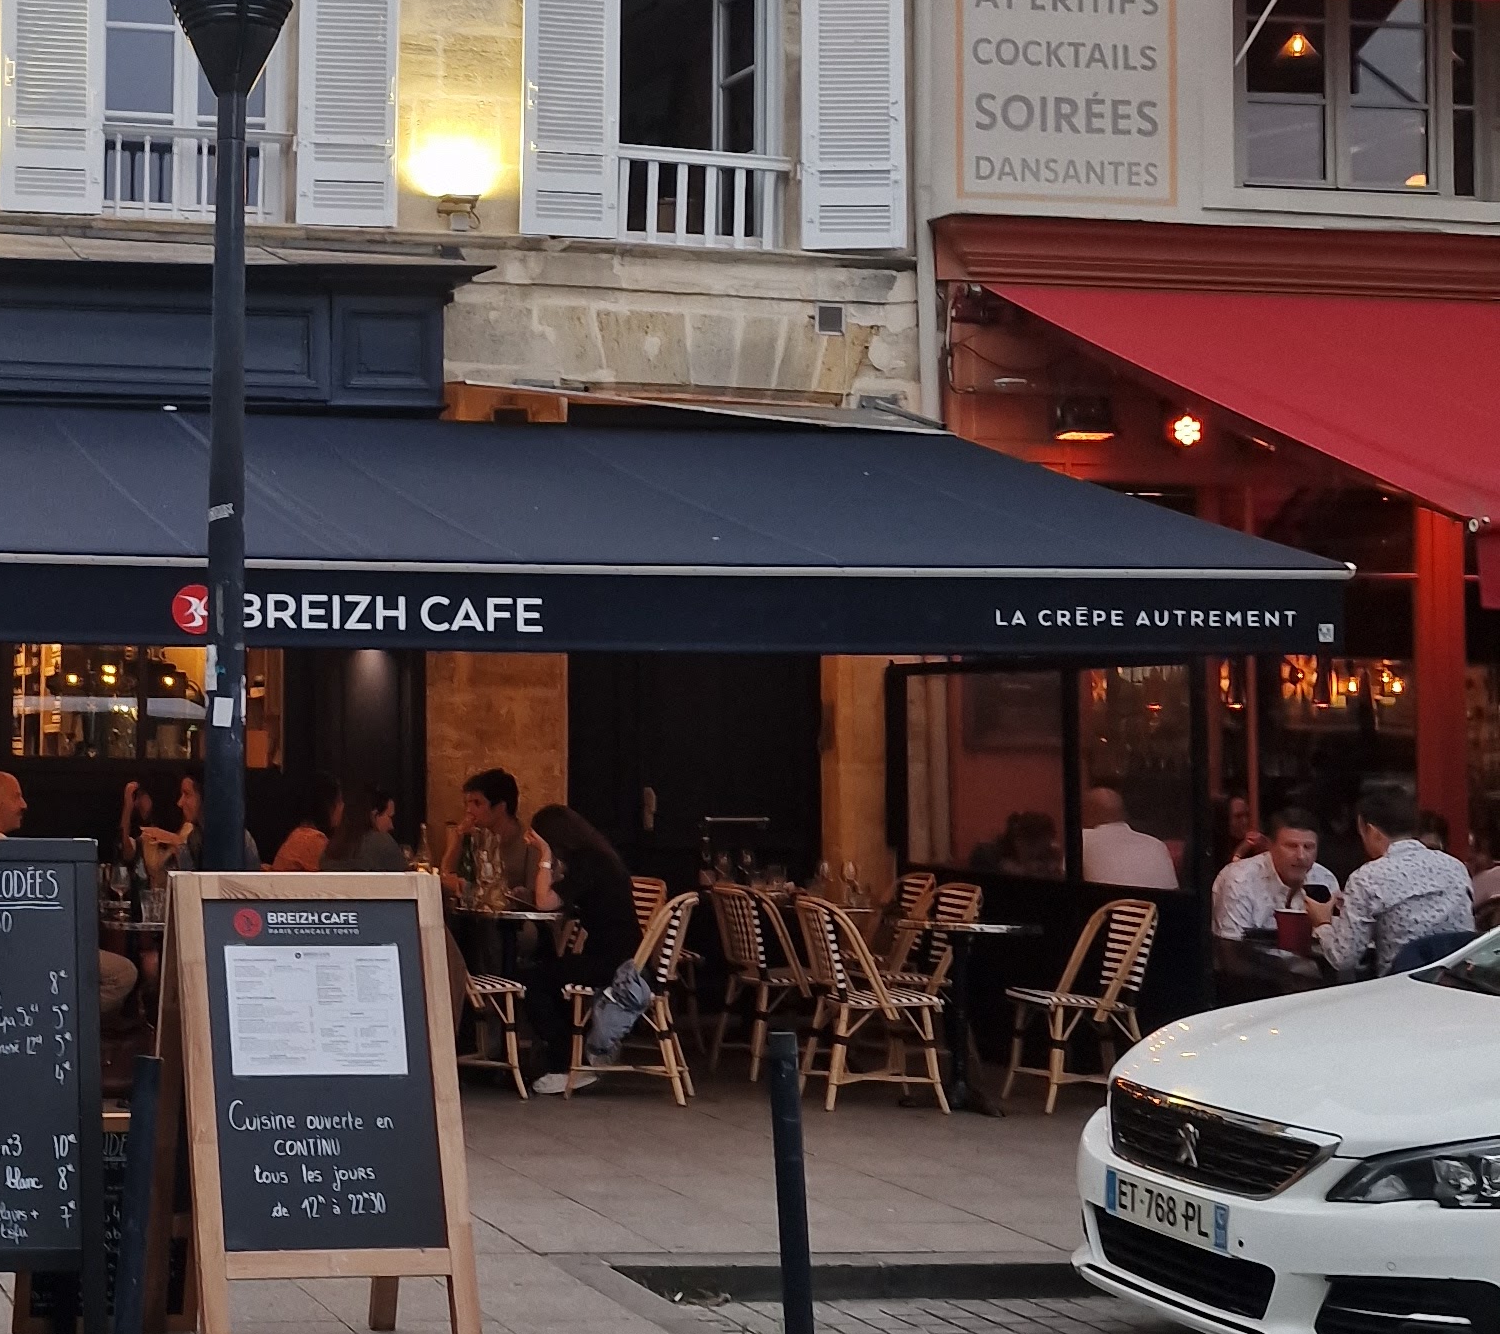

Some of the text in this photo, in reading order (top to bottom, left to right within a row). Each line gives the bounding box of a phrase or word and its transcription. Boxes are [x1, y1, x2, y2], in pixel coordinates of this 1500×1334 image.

[972, 37, 1158, 71] COCKTAILS
[974, 89, 1159, 138] SOIRÉES
[974, 155, 1159, 187] DANSANTES
[243, 592, 544, 634] BREIZH CAFE
[995, 608, 1027, 627] LA
[1136, 610, 1298, 628] AUTREMENT
[266, 912, 358, 924] BREIZH CAFE
[228, 1099, 395, 1132] Cuisine ouverte en
[4, 1165, 44, 1191] blanc
[254, 1164, 289, 1185] tous
[302, 1163, 323, 1184] les
[270, 1200, 290, 1218] de
[331, 1197, 342, 1216] à
[0, 1224, 29, 1245] tofu
